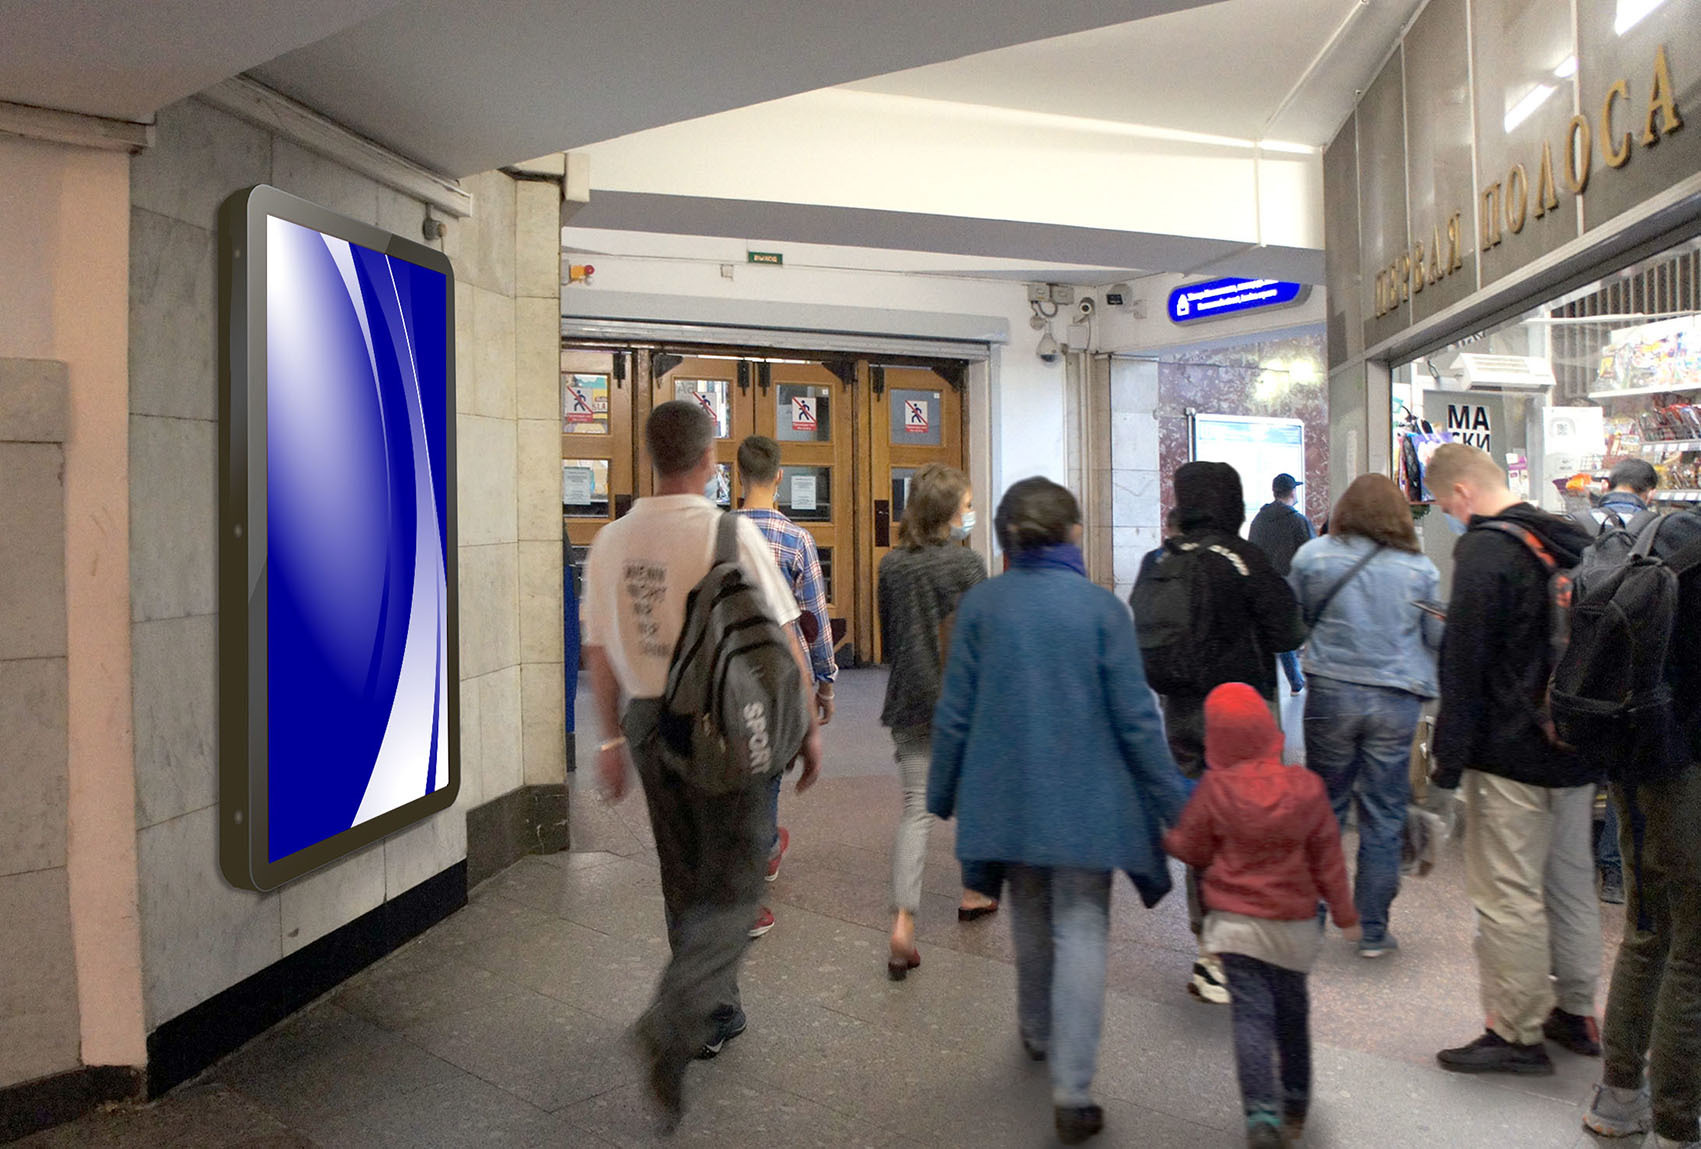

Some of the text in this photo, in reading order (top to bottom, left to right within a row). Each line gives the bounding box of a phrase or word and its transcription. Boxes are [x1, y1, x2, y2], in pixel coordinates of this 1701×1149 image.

[1375, 43, 1682, 318] ПЕРВАЯ ПОЛОСА
[1448, 404, 1490, 430] МА
[1451, 432, 1490, 453] КИ
[743, 702, 772, 774] SPORT
